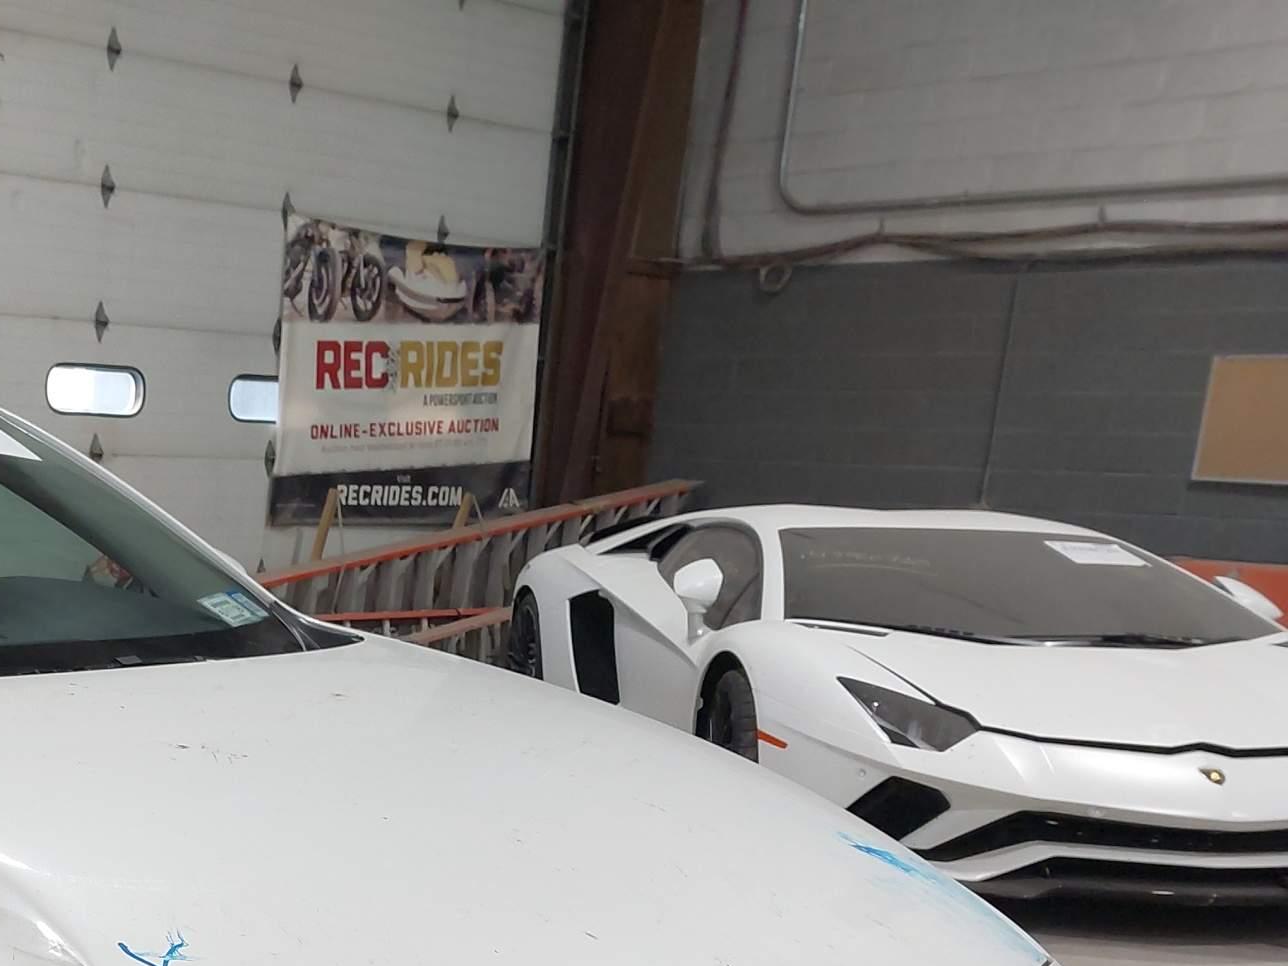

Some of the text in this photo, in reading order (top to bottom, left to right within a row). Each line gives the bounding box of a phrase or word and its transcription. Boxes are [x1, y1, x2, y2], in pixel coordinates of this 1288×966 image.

[316, 340, 504, 390] REC RIDES
[310, 418, 500, 440] ONLINE-EXCLUSIVE AUCTION
[336, 484, 463, 507] RECRIDES.COM
